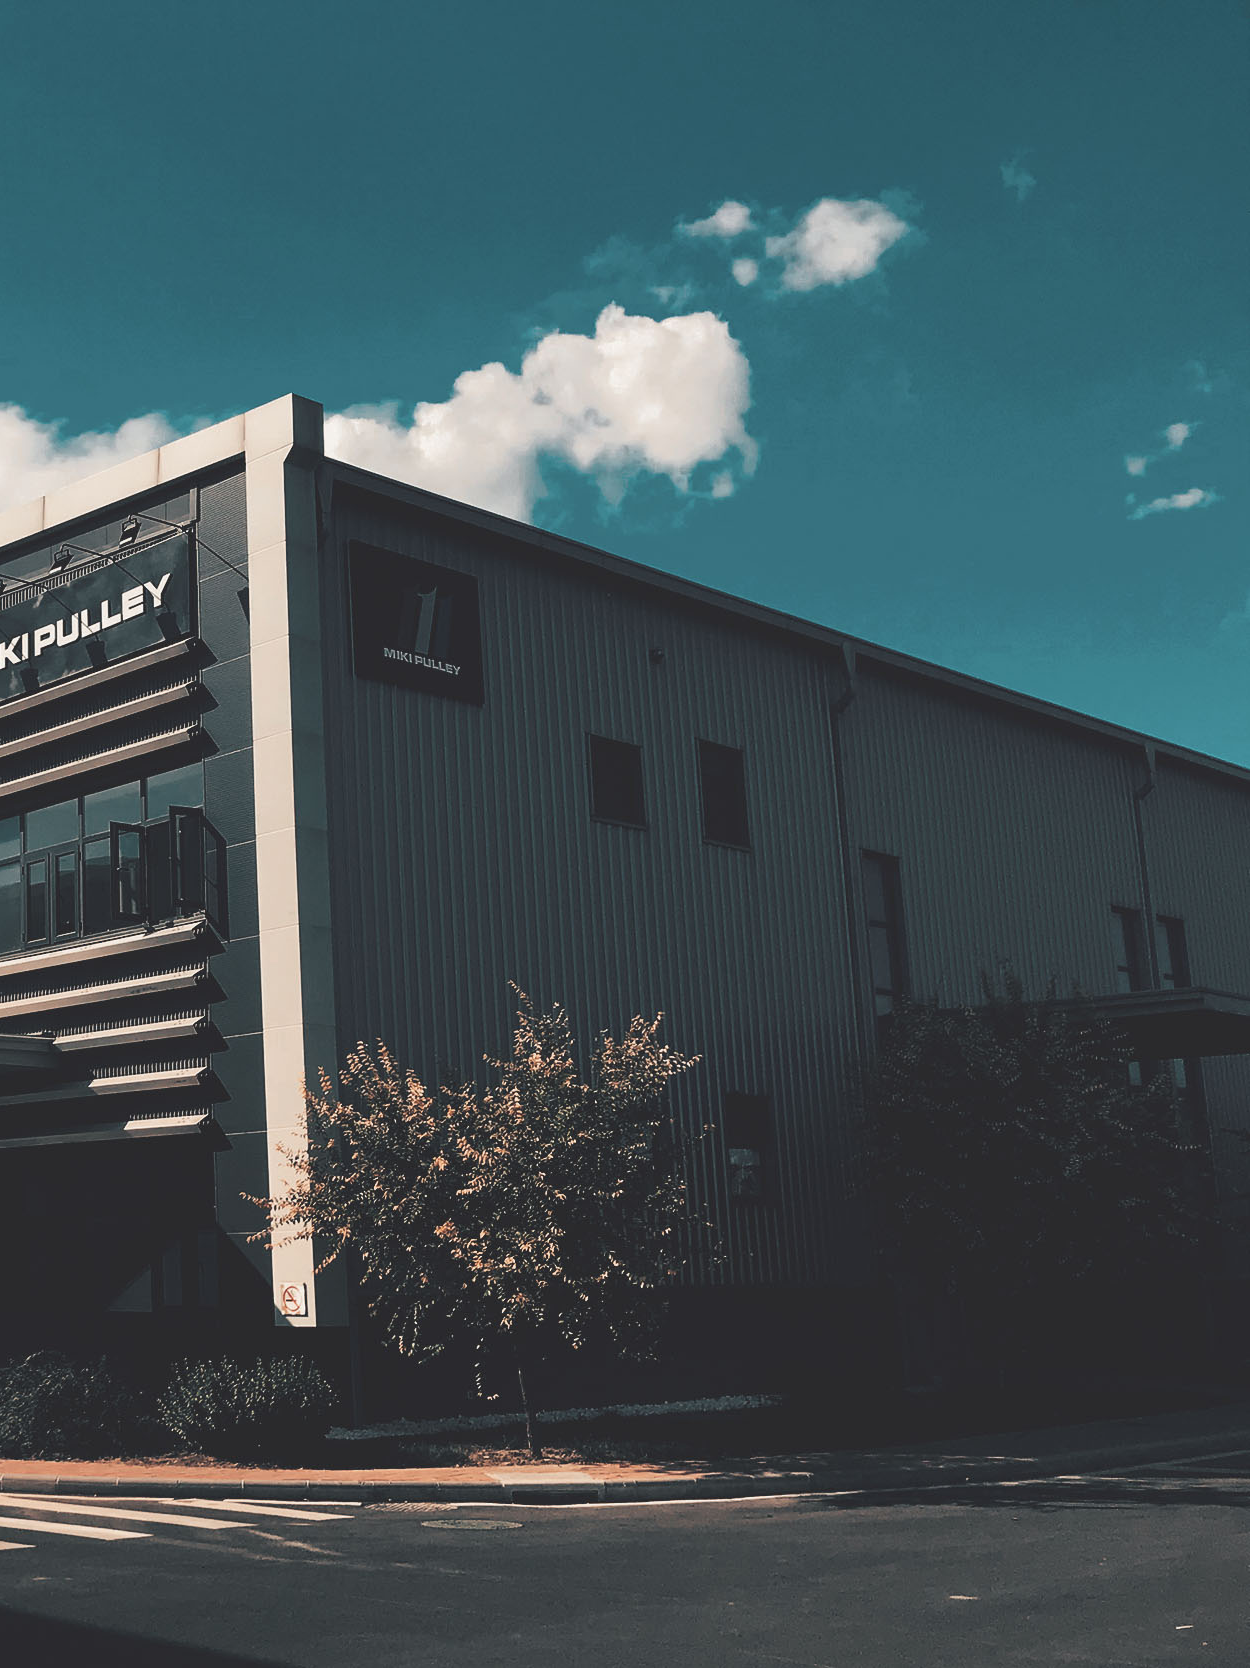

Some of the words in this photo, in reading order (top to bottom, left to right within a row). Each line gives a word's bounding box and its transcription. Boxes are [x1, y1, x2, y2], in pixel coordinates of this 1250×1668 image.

[34, 572, 172, 657] PULLEY
[383, 647, 413, 663] MIKI
[414, 655, 461, 675] PULLEY
